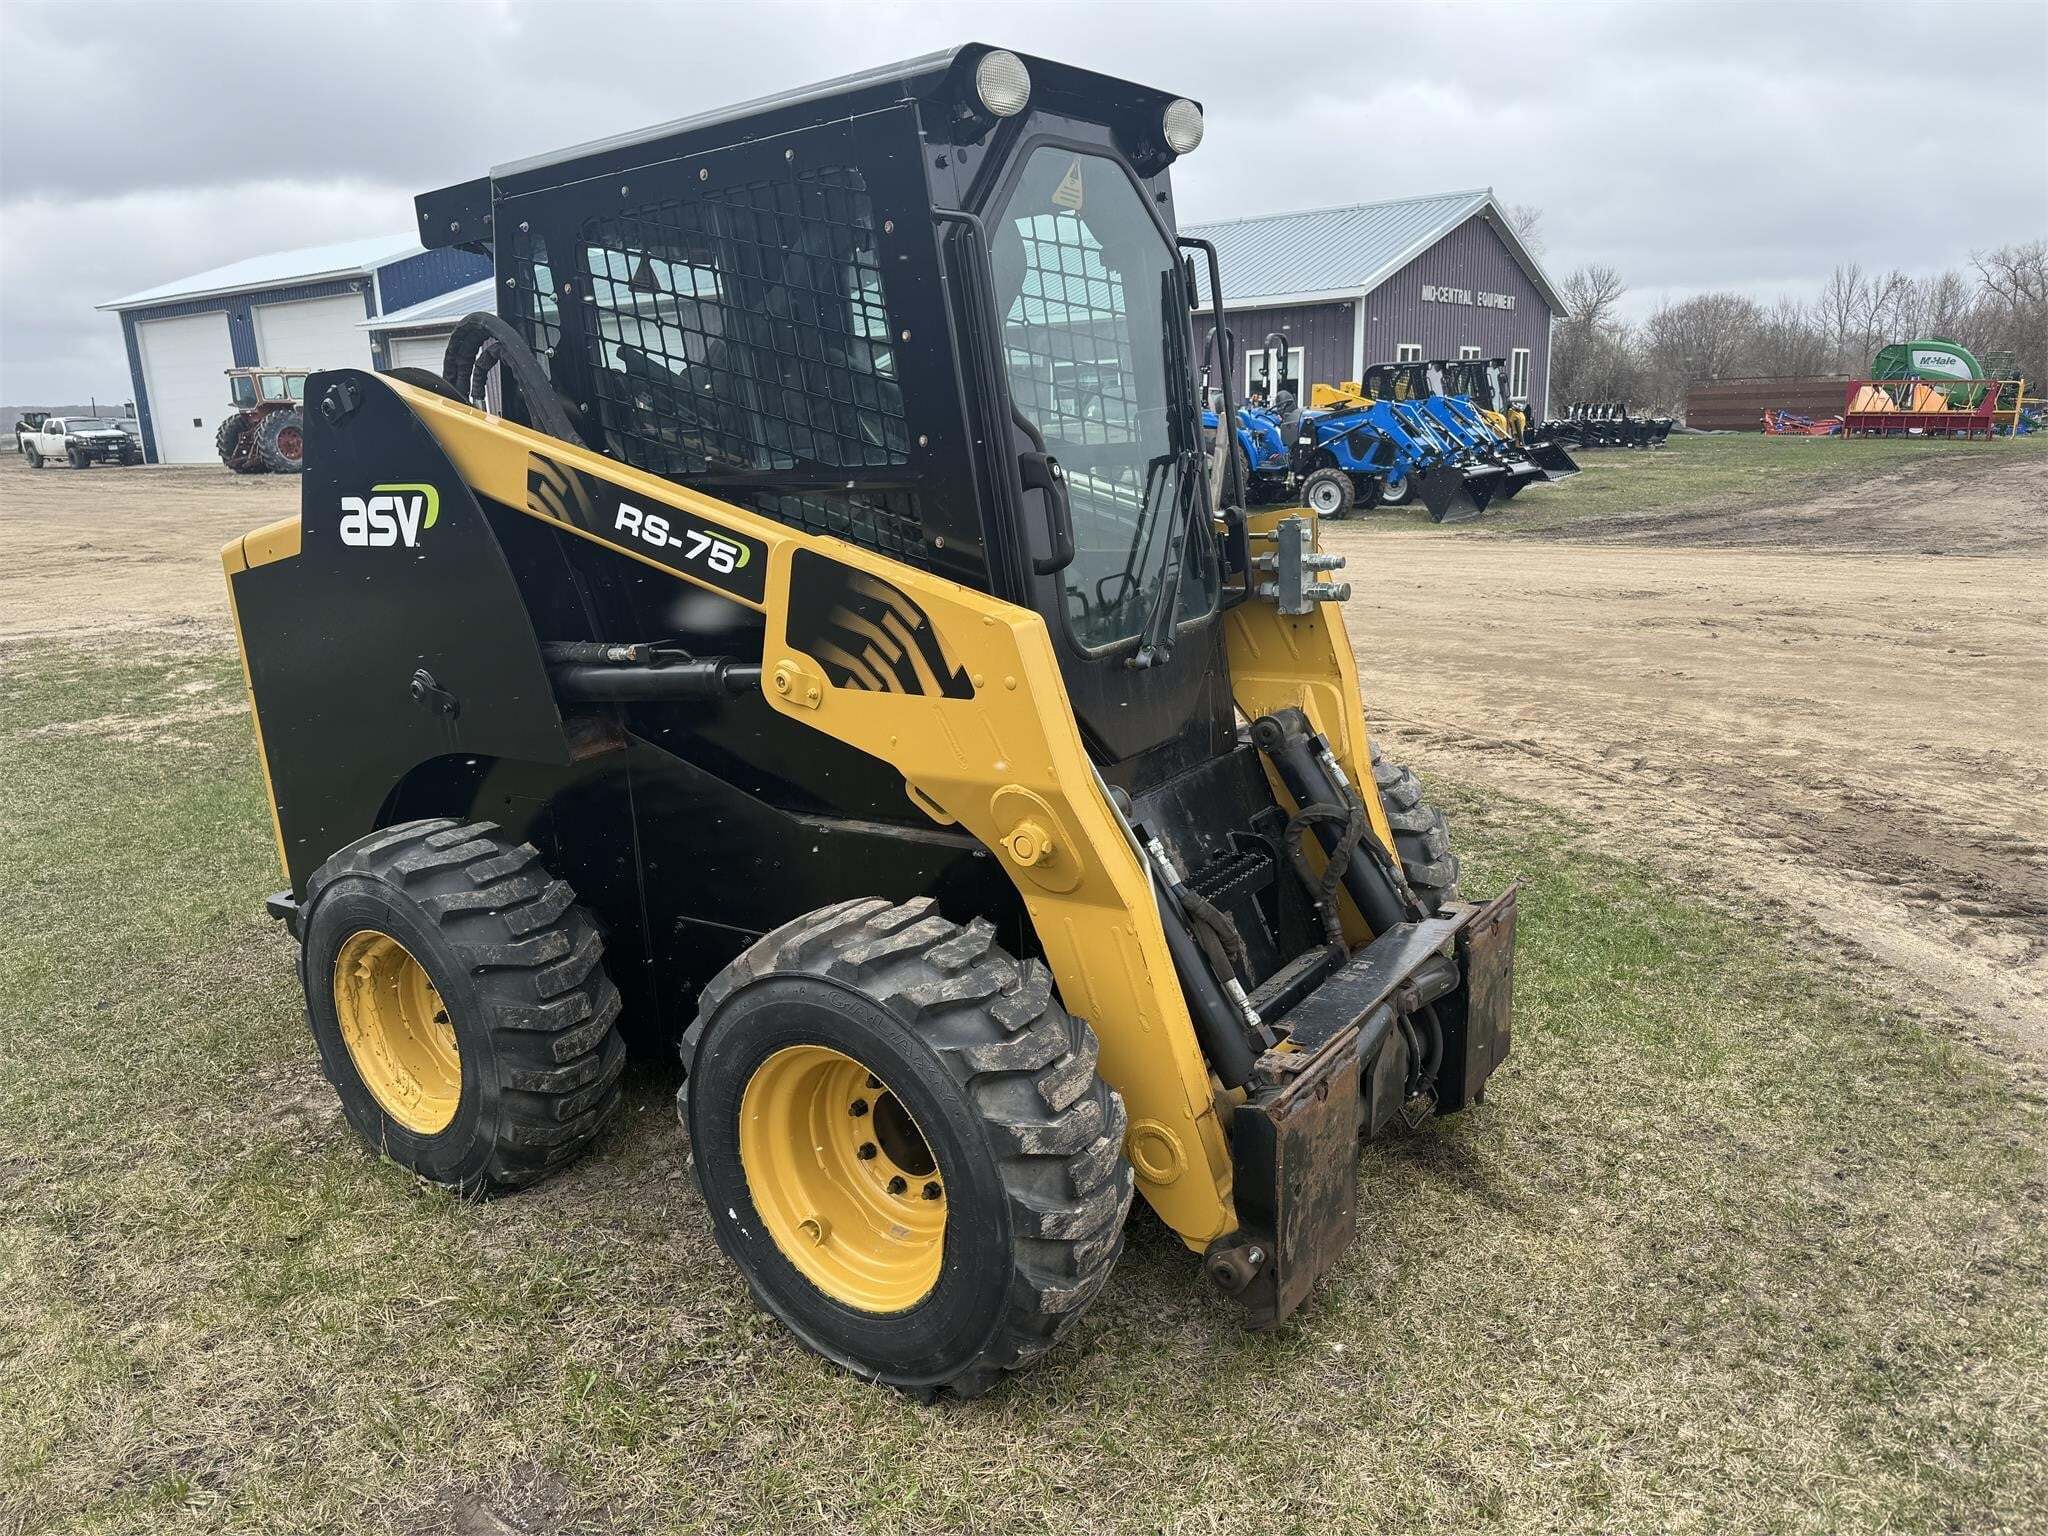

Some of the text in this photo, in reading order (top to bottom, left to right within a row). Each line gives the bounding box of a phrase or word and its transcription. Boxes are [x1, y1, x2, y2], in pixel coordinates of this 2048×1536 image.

[1477, 291, 1516, 310] EQUIPMENT
[614, 502, 738, 574] RS-75
[827, 990, 960, 1101] GALAXY
